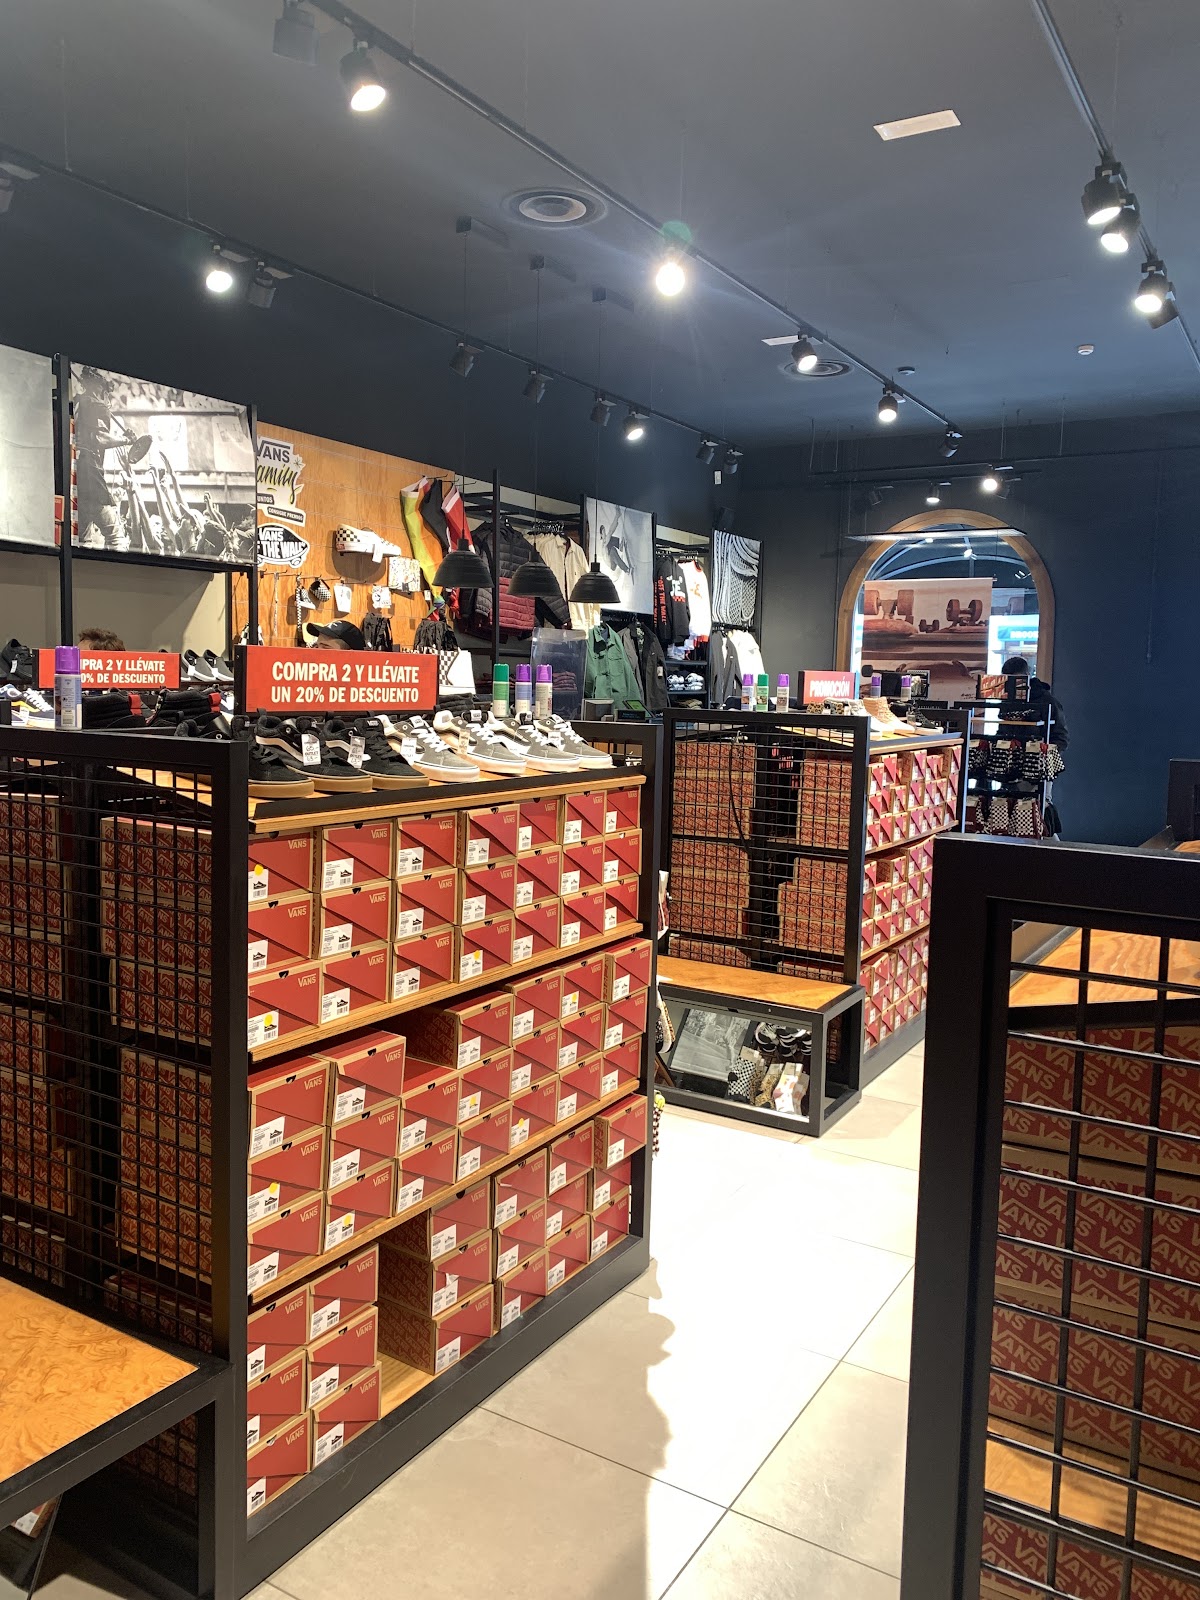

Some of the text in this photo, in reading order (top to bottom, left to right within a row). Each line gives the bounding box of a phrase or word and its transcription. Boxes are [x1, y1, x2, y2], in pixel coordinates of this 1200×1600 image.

[257, 464, 298, 504] amily
[259, 528, 284, 541] VANS
[261, 540, 280, 558] THE
[80, 656, 166, 672] PRA 2 Y LLÉVATE
[272, 660, 420, 684] COMPRA 2 Y LLÉVATE
[80, 673, 166, 684] 0% DE DESCUENTO
[271, 686, 420, 703] UN 20% DE DESCUENTO
[810, 676, 850, 698] PROMOCIÓN
[371, 829, 388, 839] VANS
[288, 838, 307, 850] VANS
[438, 878, 453, 890] VANS
[370, 892, 386, 904] VANS
[288, 905, 307, 918] VANS
[368, 954, 385, 966] VANS
[298, 974, 316, 988] VANS
[385, 1050, 402, 1063] VANS
[304, 1075, 323, 1090] VANS
[378, 1110, 395, 1126] VANS
[300, 1140, 320, 1157] VANS
[373, 1171, 390, 1188] VANS
[471, 1188, 486, 1203] VANS
[300, 1206, 318, 1222] VANS
[474, 1244, 488, 1257] VANS
[356, 1256, 374, 1273] VANS
[285, 1295, 304, 1315] VANS
[475, 1298, 490, 1312] VANS
[356, 1320, 373, 1338] VANS
[280, 1365, 300, 1384] VANS
[360, 1376, 377, 1394] VANS
[286, 1424, 305, 1446] VANS
[1057, 1541, 1114, 1597] VANS
